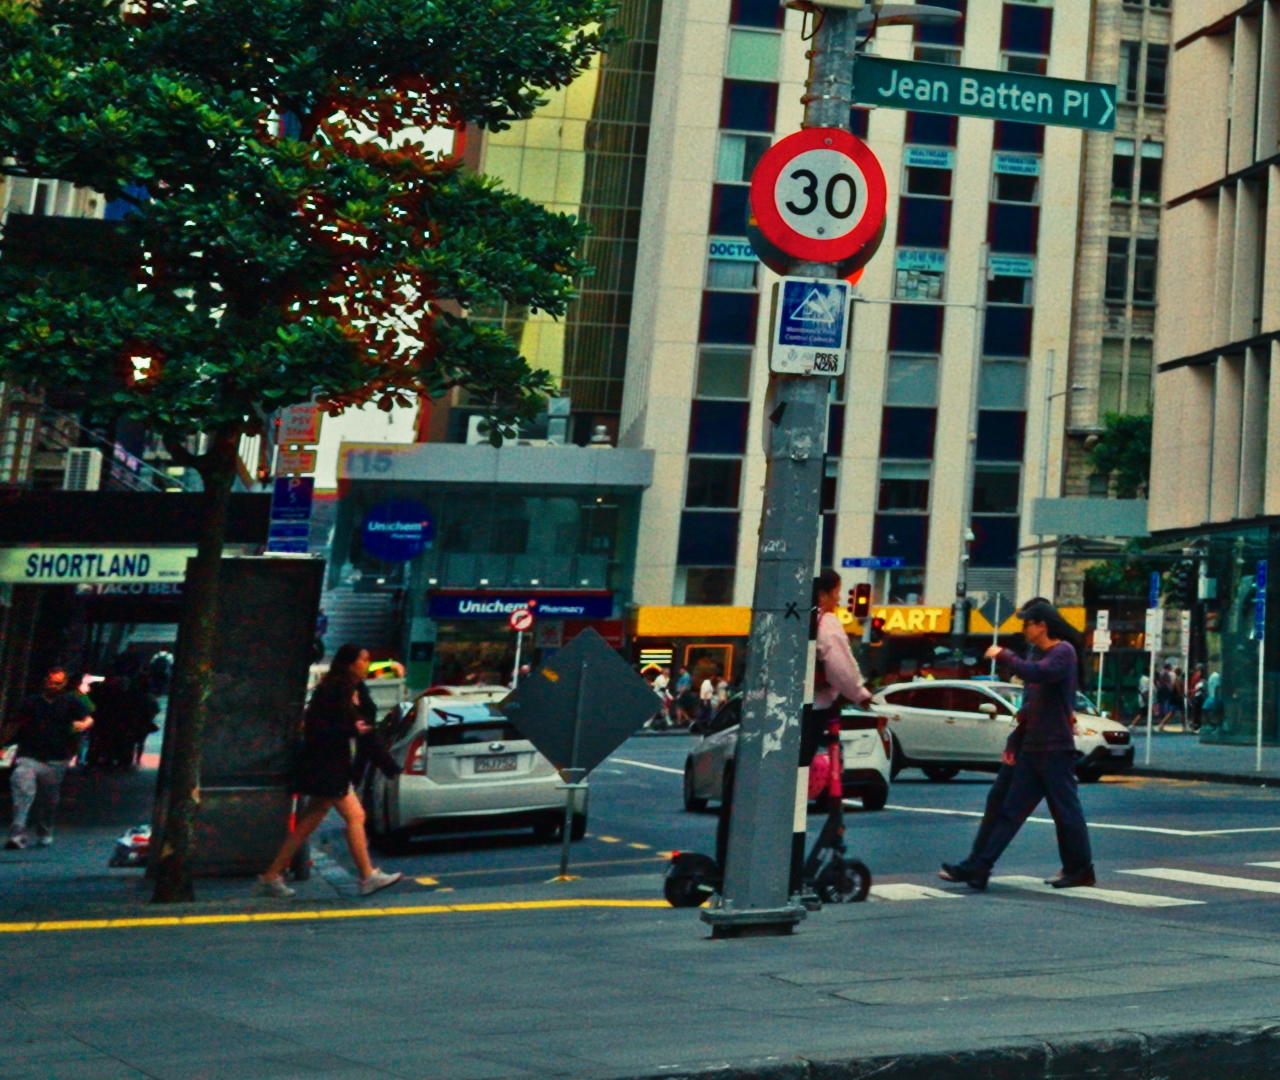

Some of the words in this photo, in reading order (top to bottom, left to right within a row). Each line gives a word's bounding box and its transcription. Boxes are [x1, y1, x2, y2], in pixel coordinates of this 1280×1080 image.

[877, 69, 948, 103] Jean
[959, 77, 1053, 115] Batten
[1063, 89, 1089, 118] Pl
[785, 169, 857, 219] 30
[709, 243, 756, 256] DOCTO
[367, 521, 422, 533] Unichem
[25, 553, 151, 578] SHORTLAND
[97, 583, 144, 595] TACO
[148, 583, 183, 595] BEL
[458, 600, 529, 614] Unichem
[539, 605, 585, 614] Pharmacy
